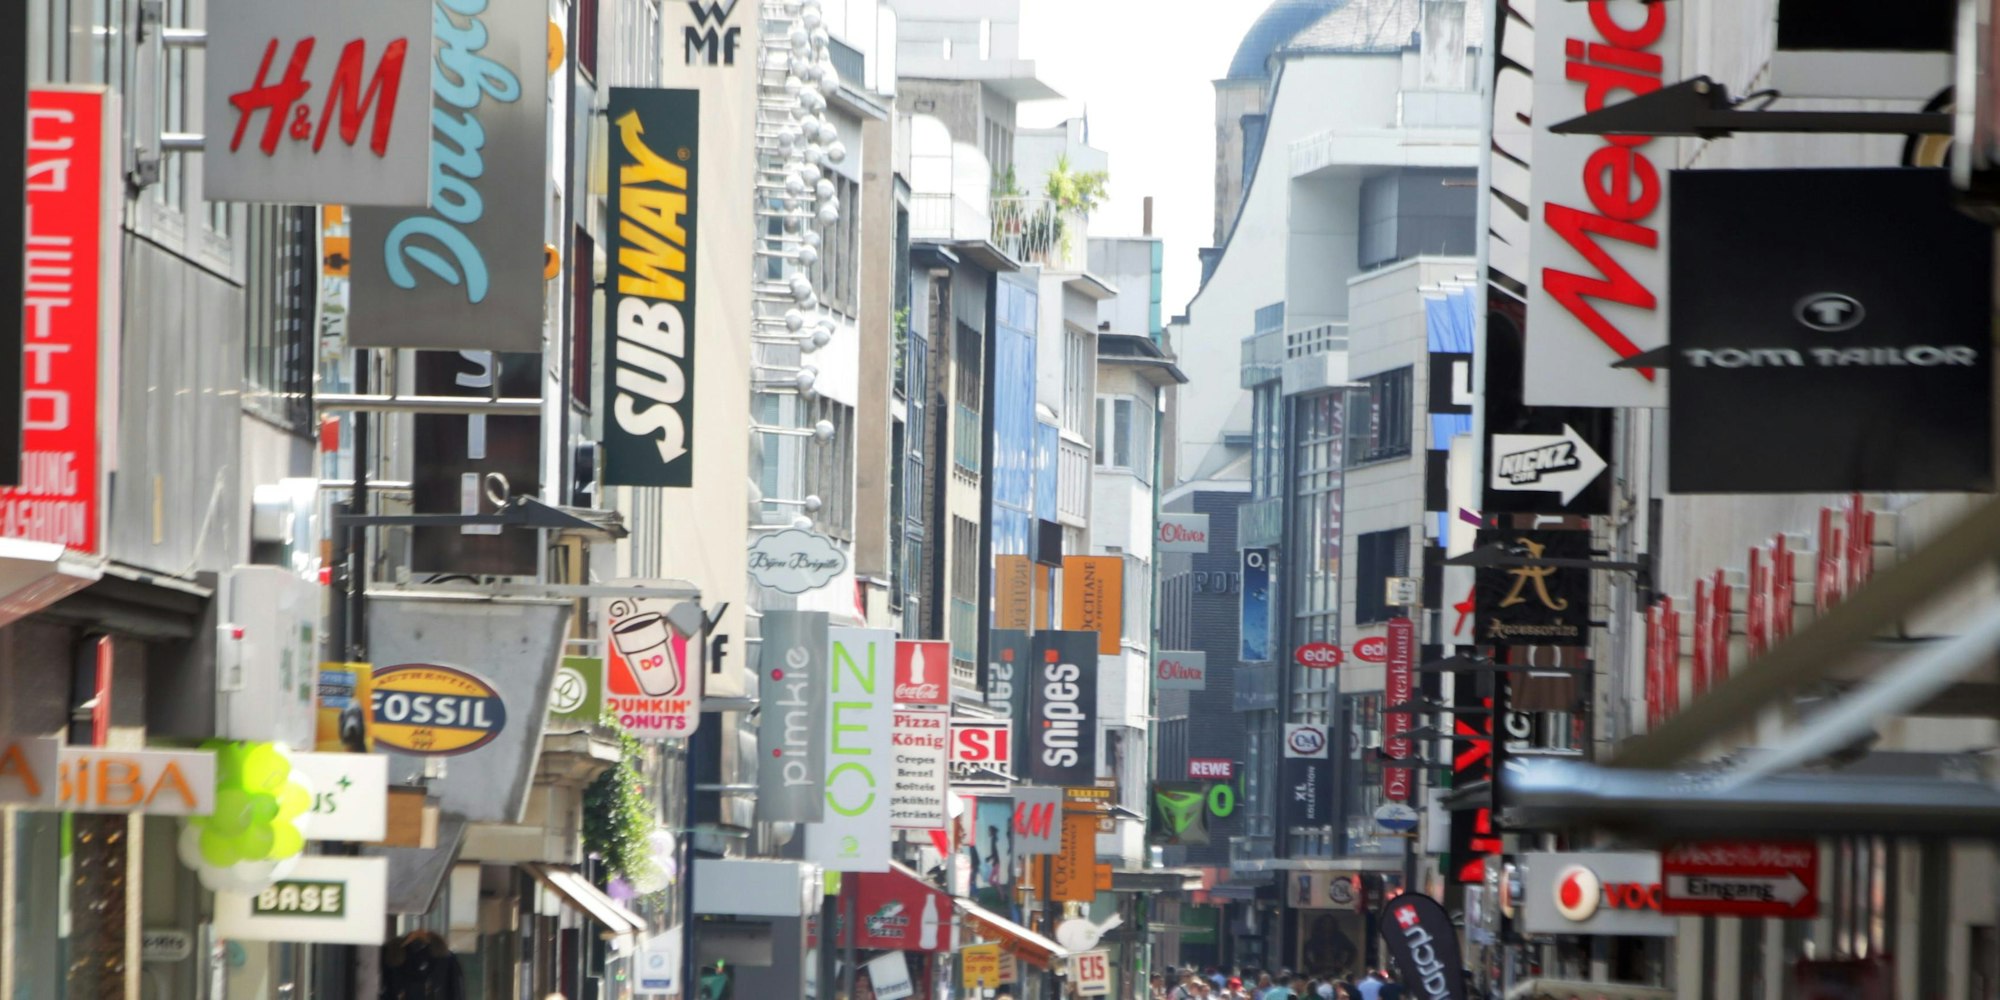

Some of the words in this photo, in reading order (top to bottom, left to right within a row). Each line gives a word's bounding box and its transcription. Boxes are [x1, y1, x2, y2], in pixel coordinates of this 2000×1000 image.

[229, 36, 408, 157] H&M
[613, 108, 689, 464] SUBWAY
[1684, 348, 1803, 368] TOM
[1809, 346, 1978, 367] TAILOR
[1488, 617, 1579, 639] Accessorize
[1304, 647, 1336, 662] edc
[618, 715, 687, 730] ONUTS
[771, 646, 814, 789] pimkie
[894, 715, 941, 728] Pizza
[1042, 663, 1086, 768] snipes
[826, 641, 876, 817] NEO
[892, 732, 944, 750] König
[896, 755, 935, 765] Crepes
[1190, 762, 1230, 776] REWE
[898, 769, 934, 777] Brezel
[895, 782, 935, 791] Softeis
[1295, 783, 1307, 801] XL
[257, 885, 341, 913] BASE
[1687, 878, 1775, 902] Eingang
[1079, 956, 1105, 981] EIS
